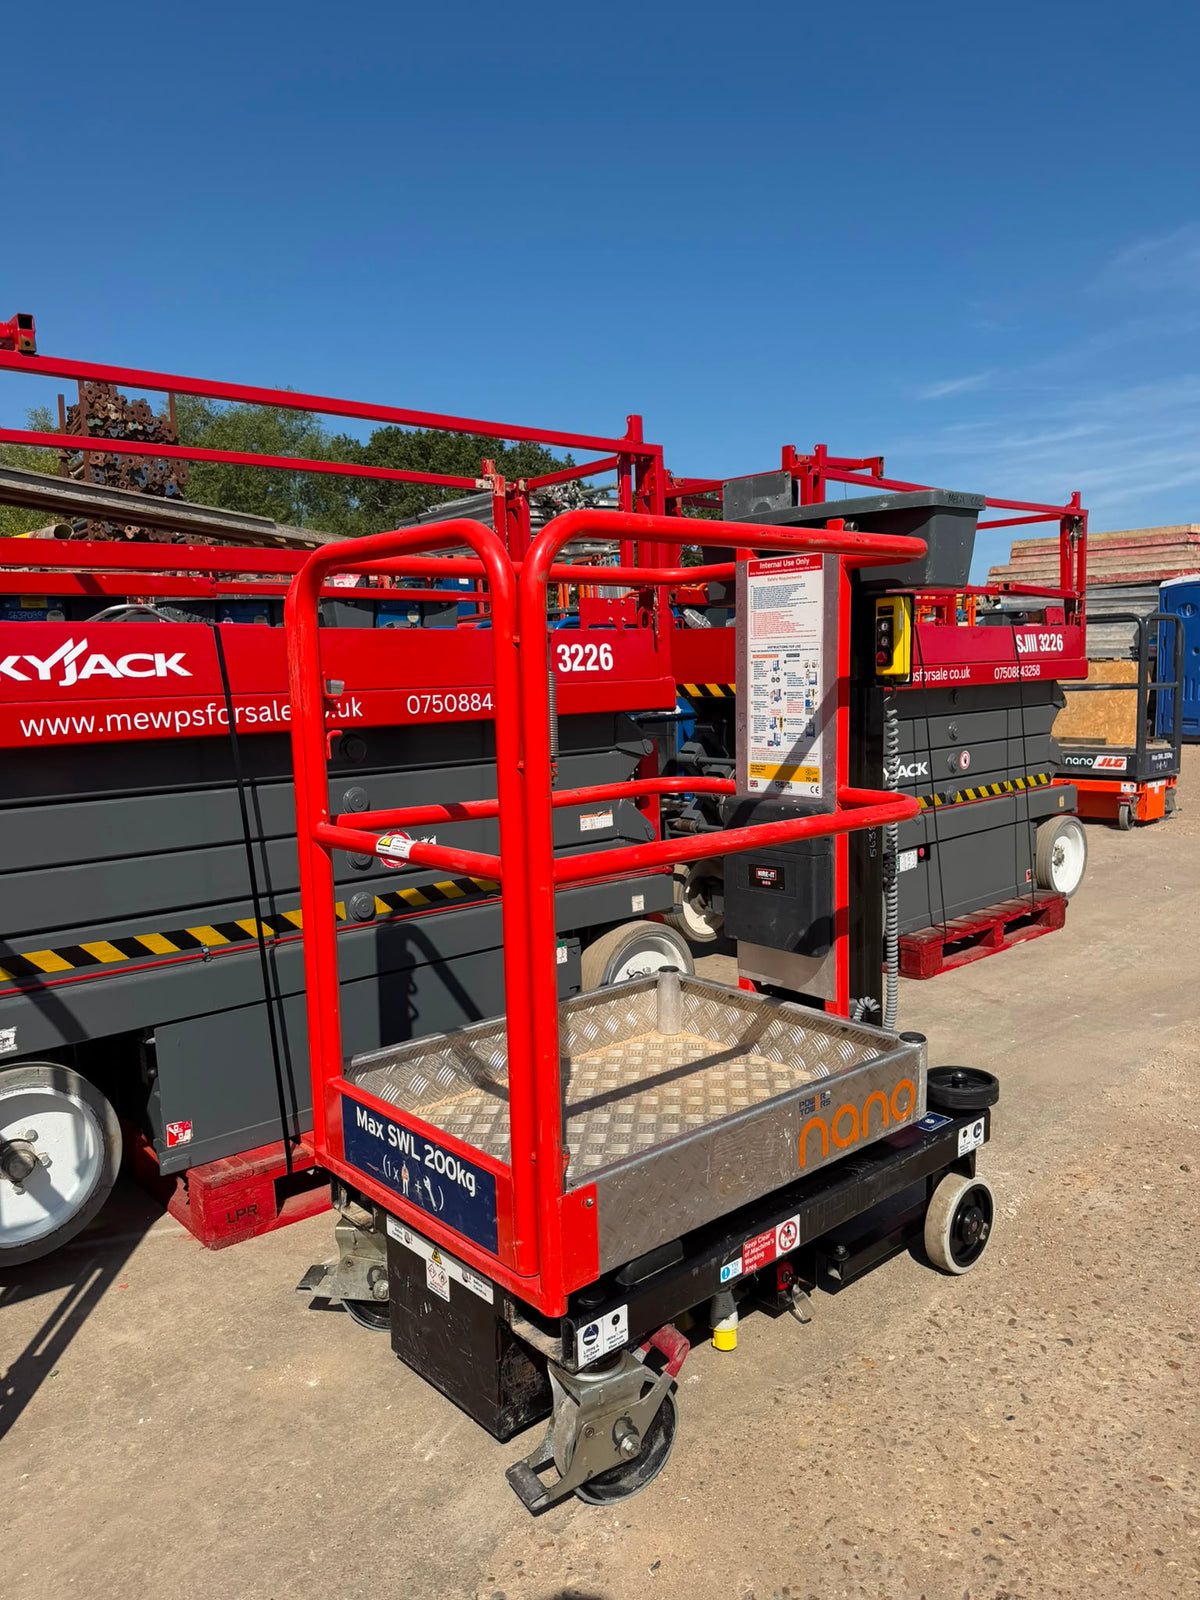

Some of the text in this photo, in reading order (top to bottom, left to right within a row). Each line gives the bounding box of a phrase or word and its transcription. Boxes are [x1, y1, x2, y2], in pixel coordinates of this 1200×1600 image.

[760, 557, 810, 569] Internal Use Only
[1038, 633, 1064, 652] 3226
[0, 637, 193, 687] KYJACK
[556, 643, 614, 672] 3226
[406, 693, 495, 714] 0750884
[1065, 756, 1126, 768] nano JLG
[799, 1078, 916, 1168] nano
[356, 1106, 476, 1198] Max SWL 200kg
[226, 1204, 258, 1224] LPR
[744, 1232, 772, 1251] Keep Clear
[744, 1251, 765, 1265] Working
[745, 1263, 757, 1273] Area
